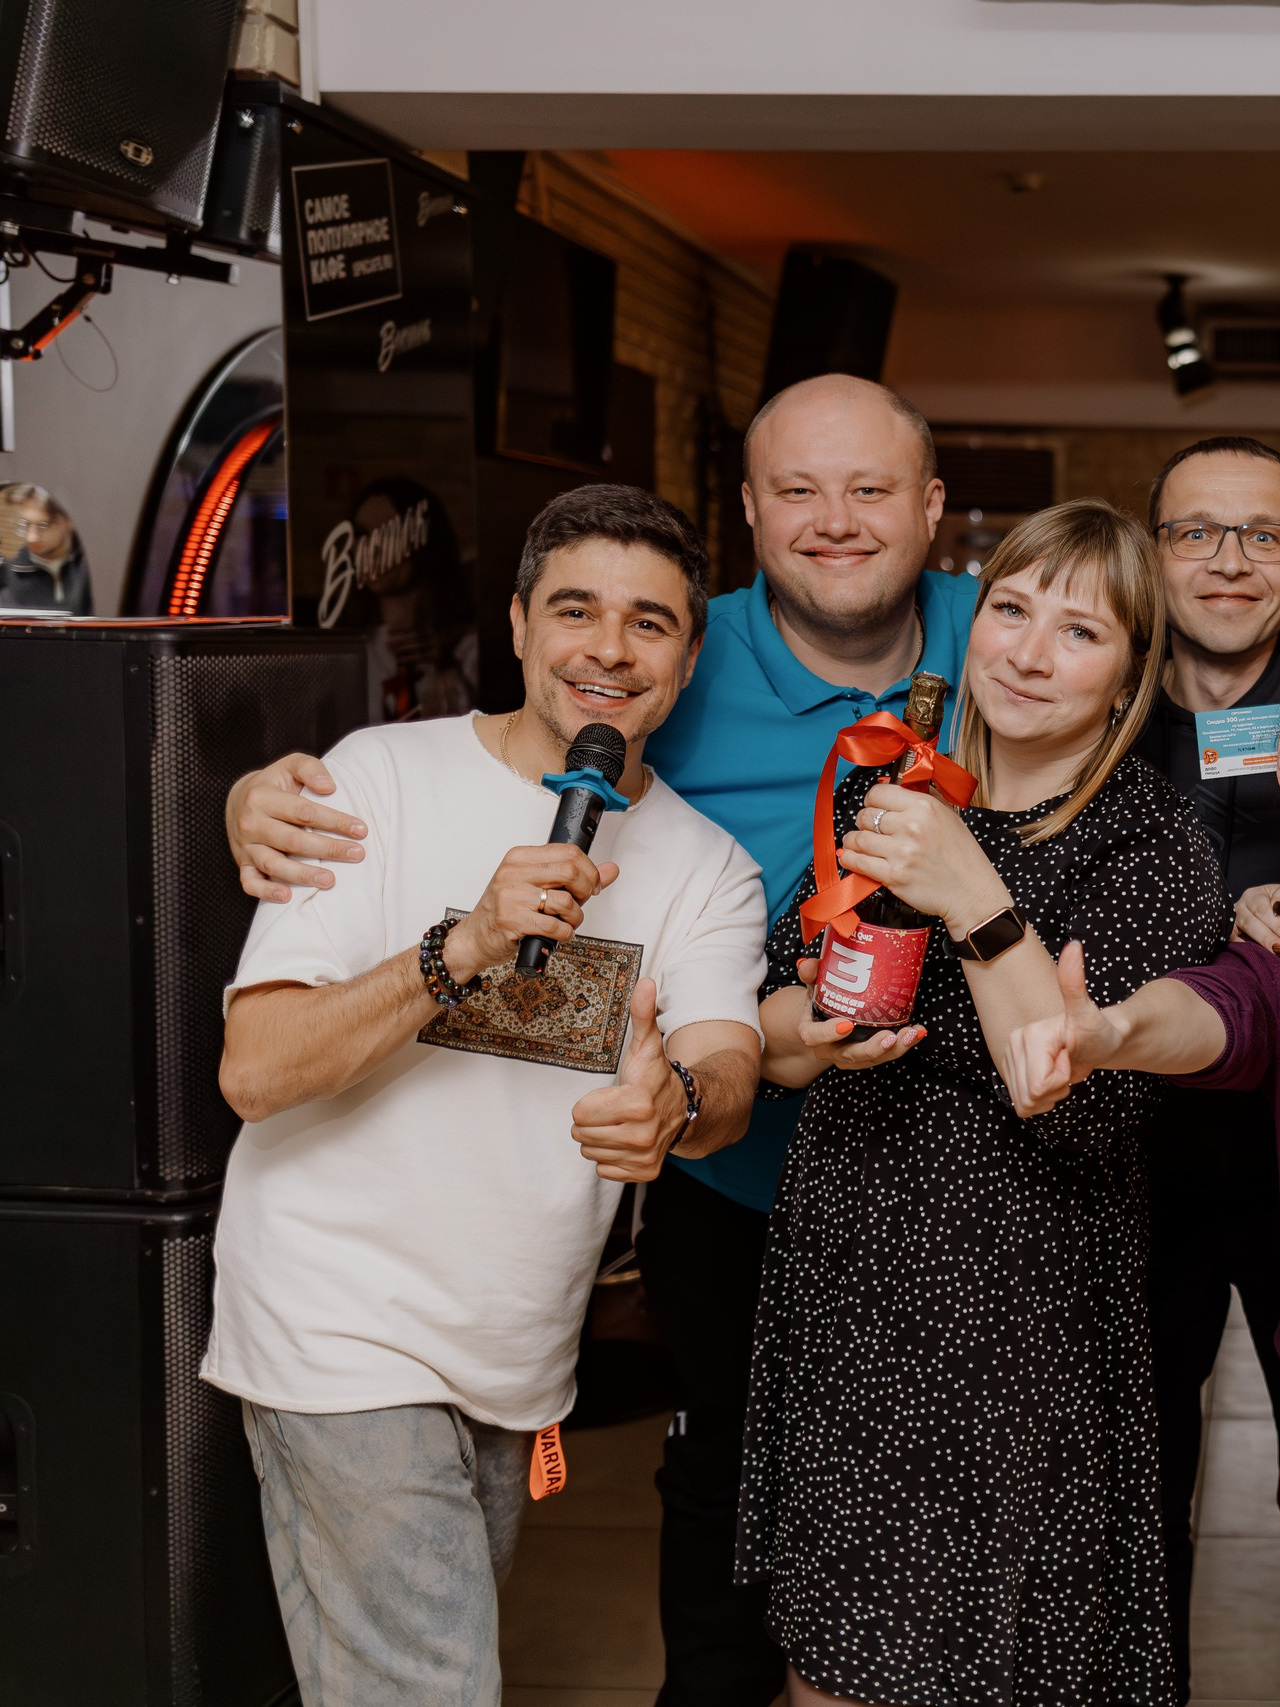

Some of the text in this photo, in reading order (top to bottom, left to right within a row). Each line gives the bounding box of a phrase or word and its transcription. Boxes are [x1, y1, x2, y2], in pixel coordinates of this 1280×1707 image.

[310, 254, 348, 285] КАФЕ
[825, 940, 875, 994] 3
[820, 984, 866, 1009] Русская
